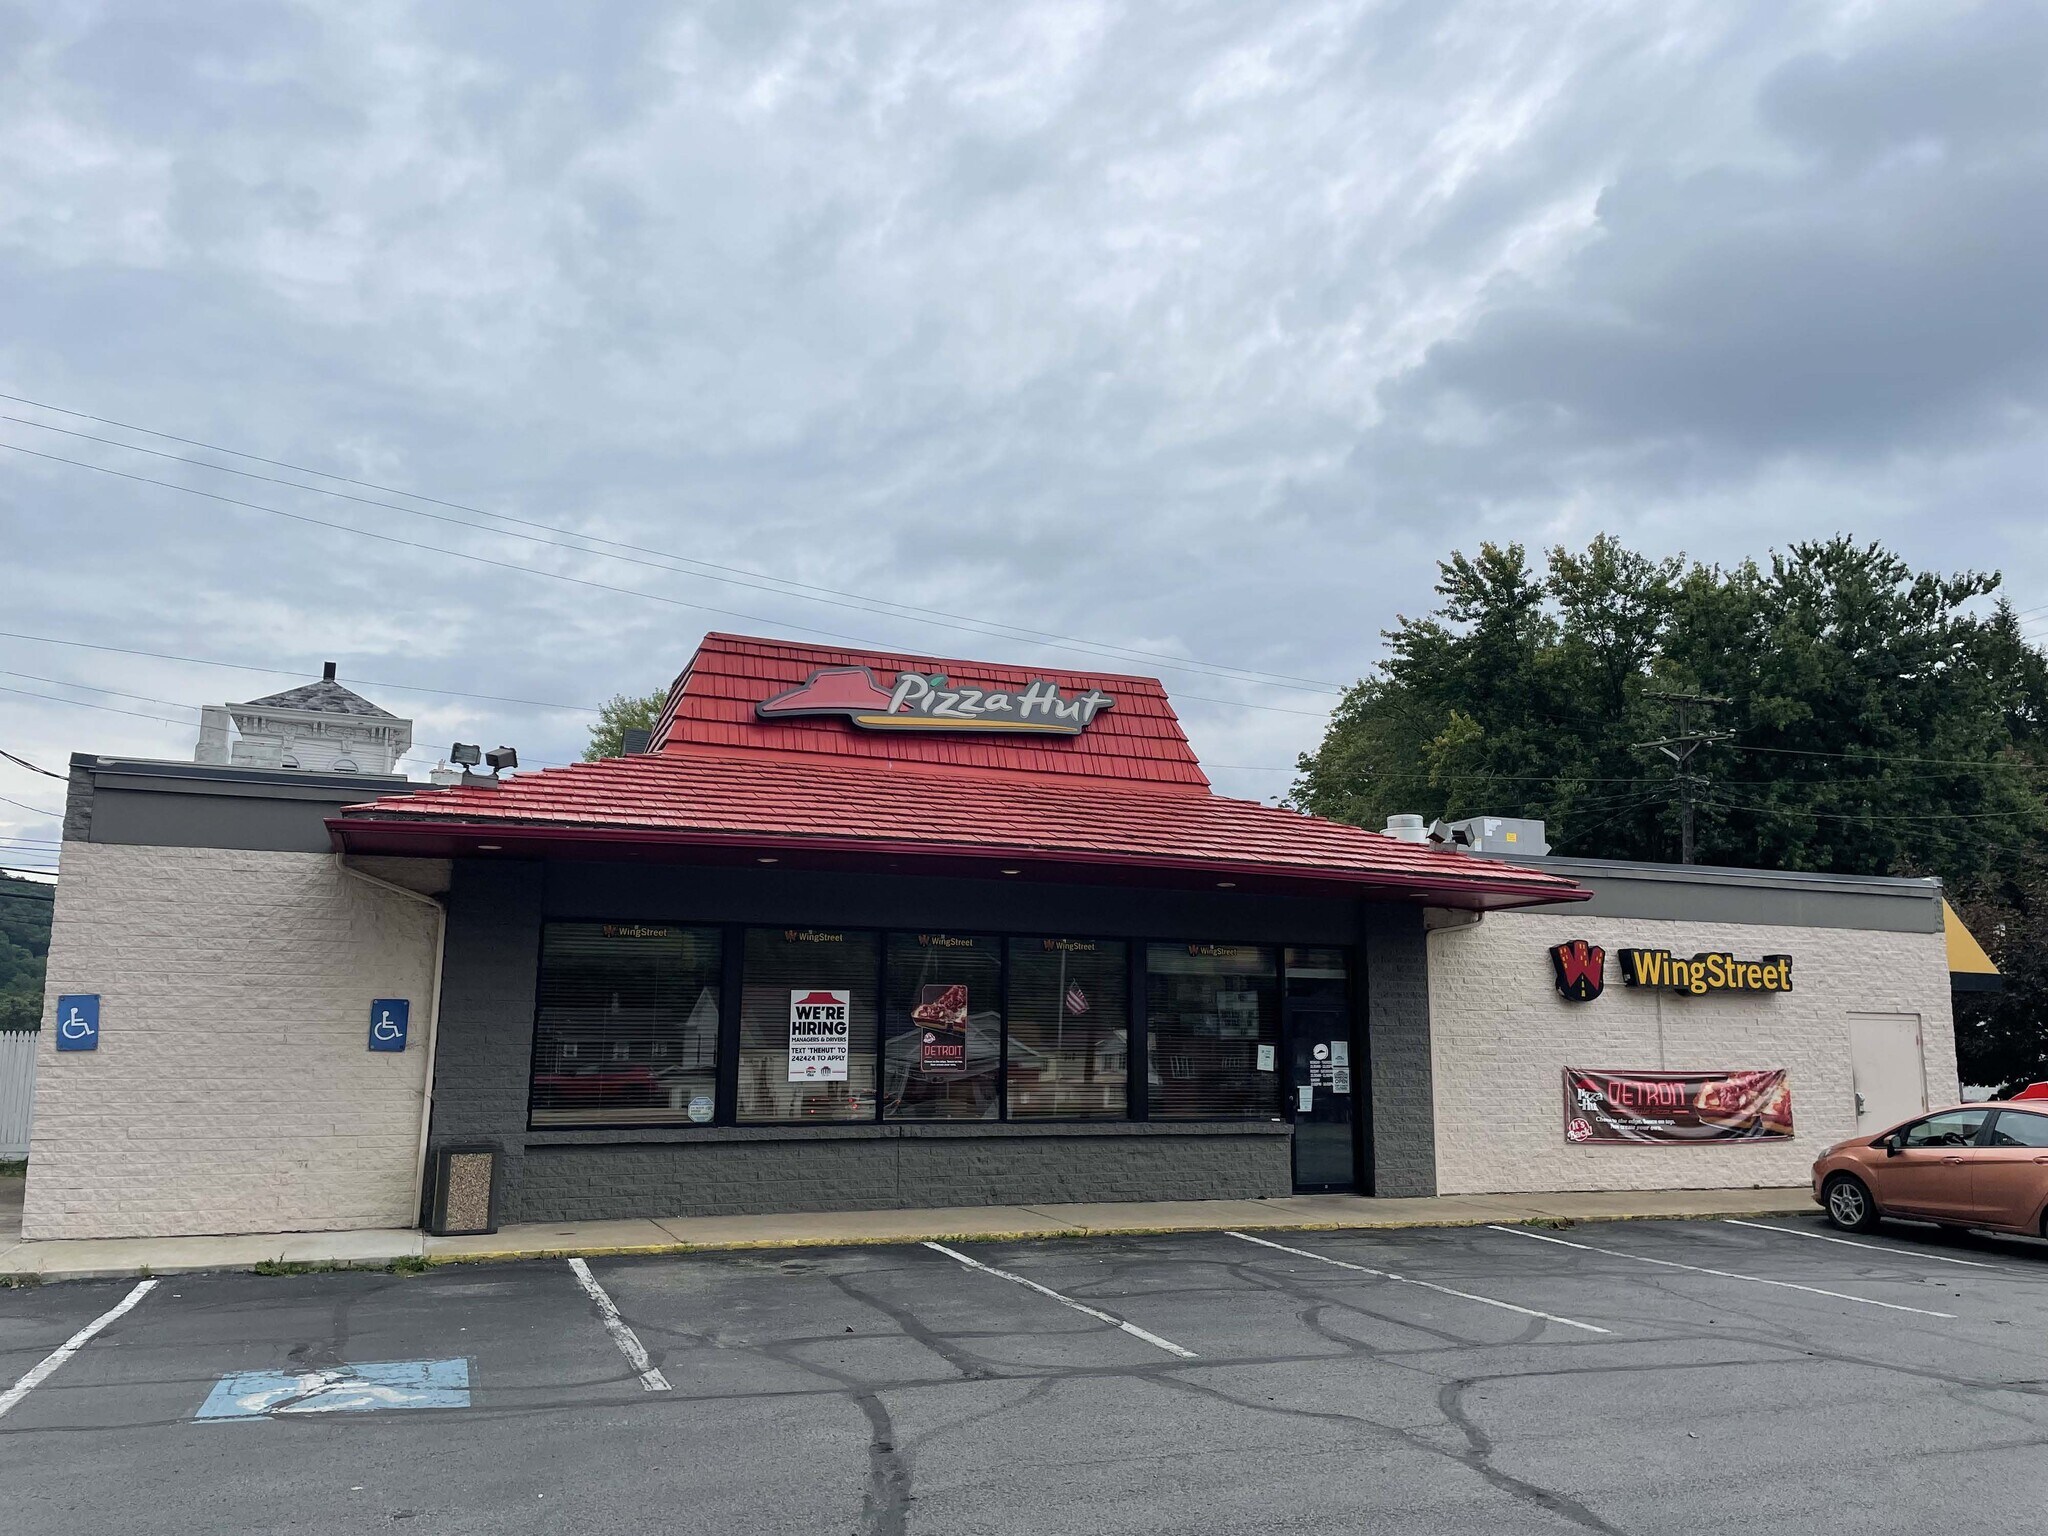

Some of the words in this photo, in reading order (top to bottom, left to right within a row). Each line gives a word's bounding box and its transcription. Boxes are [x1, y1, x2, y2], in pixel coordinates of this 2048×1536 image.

[888, 673, 1012, 719] Pizza
[1017, 681, 1113, 721] Hut
[619, 927, 668, 938] WingStreet
[799, 932, 843, 943] WingStreet
[932, 936, 974, 947] WingStreet
[1056, 941, 1095, 952] WingStreet
[1633, 951, 1790, 994] WingStreet
[796, 1006, 844, 1020] WE'RE
[792, 1021, 847, 1035] HIRING
[925, 1045, 962, 1056] DETROIT
[1608, 1082, 1686, 1106] DETROIT
[1571, 1120, 1586, 1131] It's
[1567, 1126, 1594, 1140] Back!
